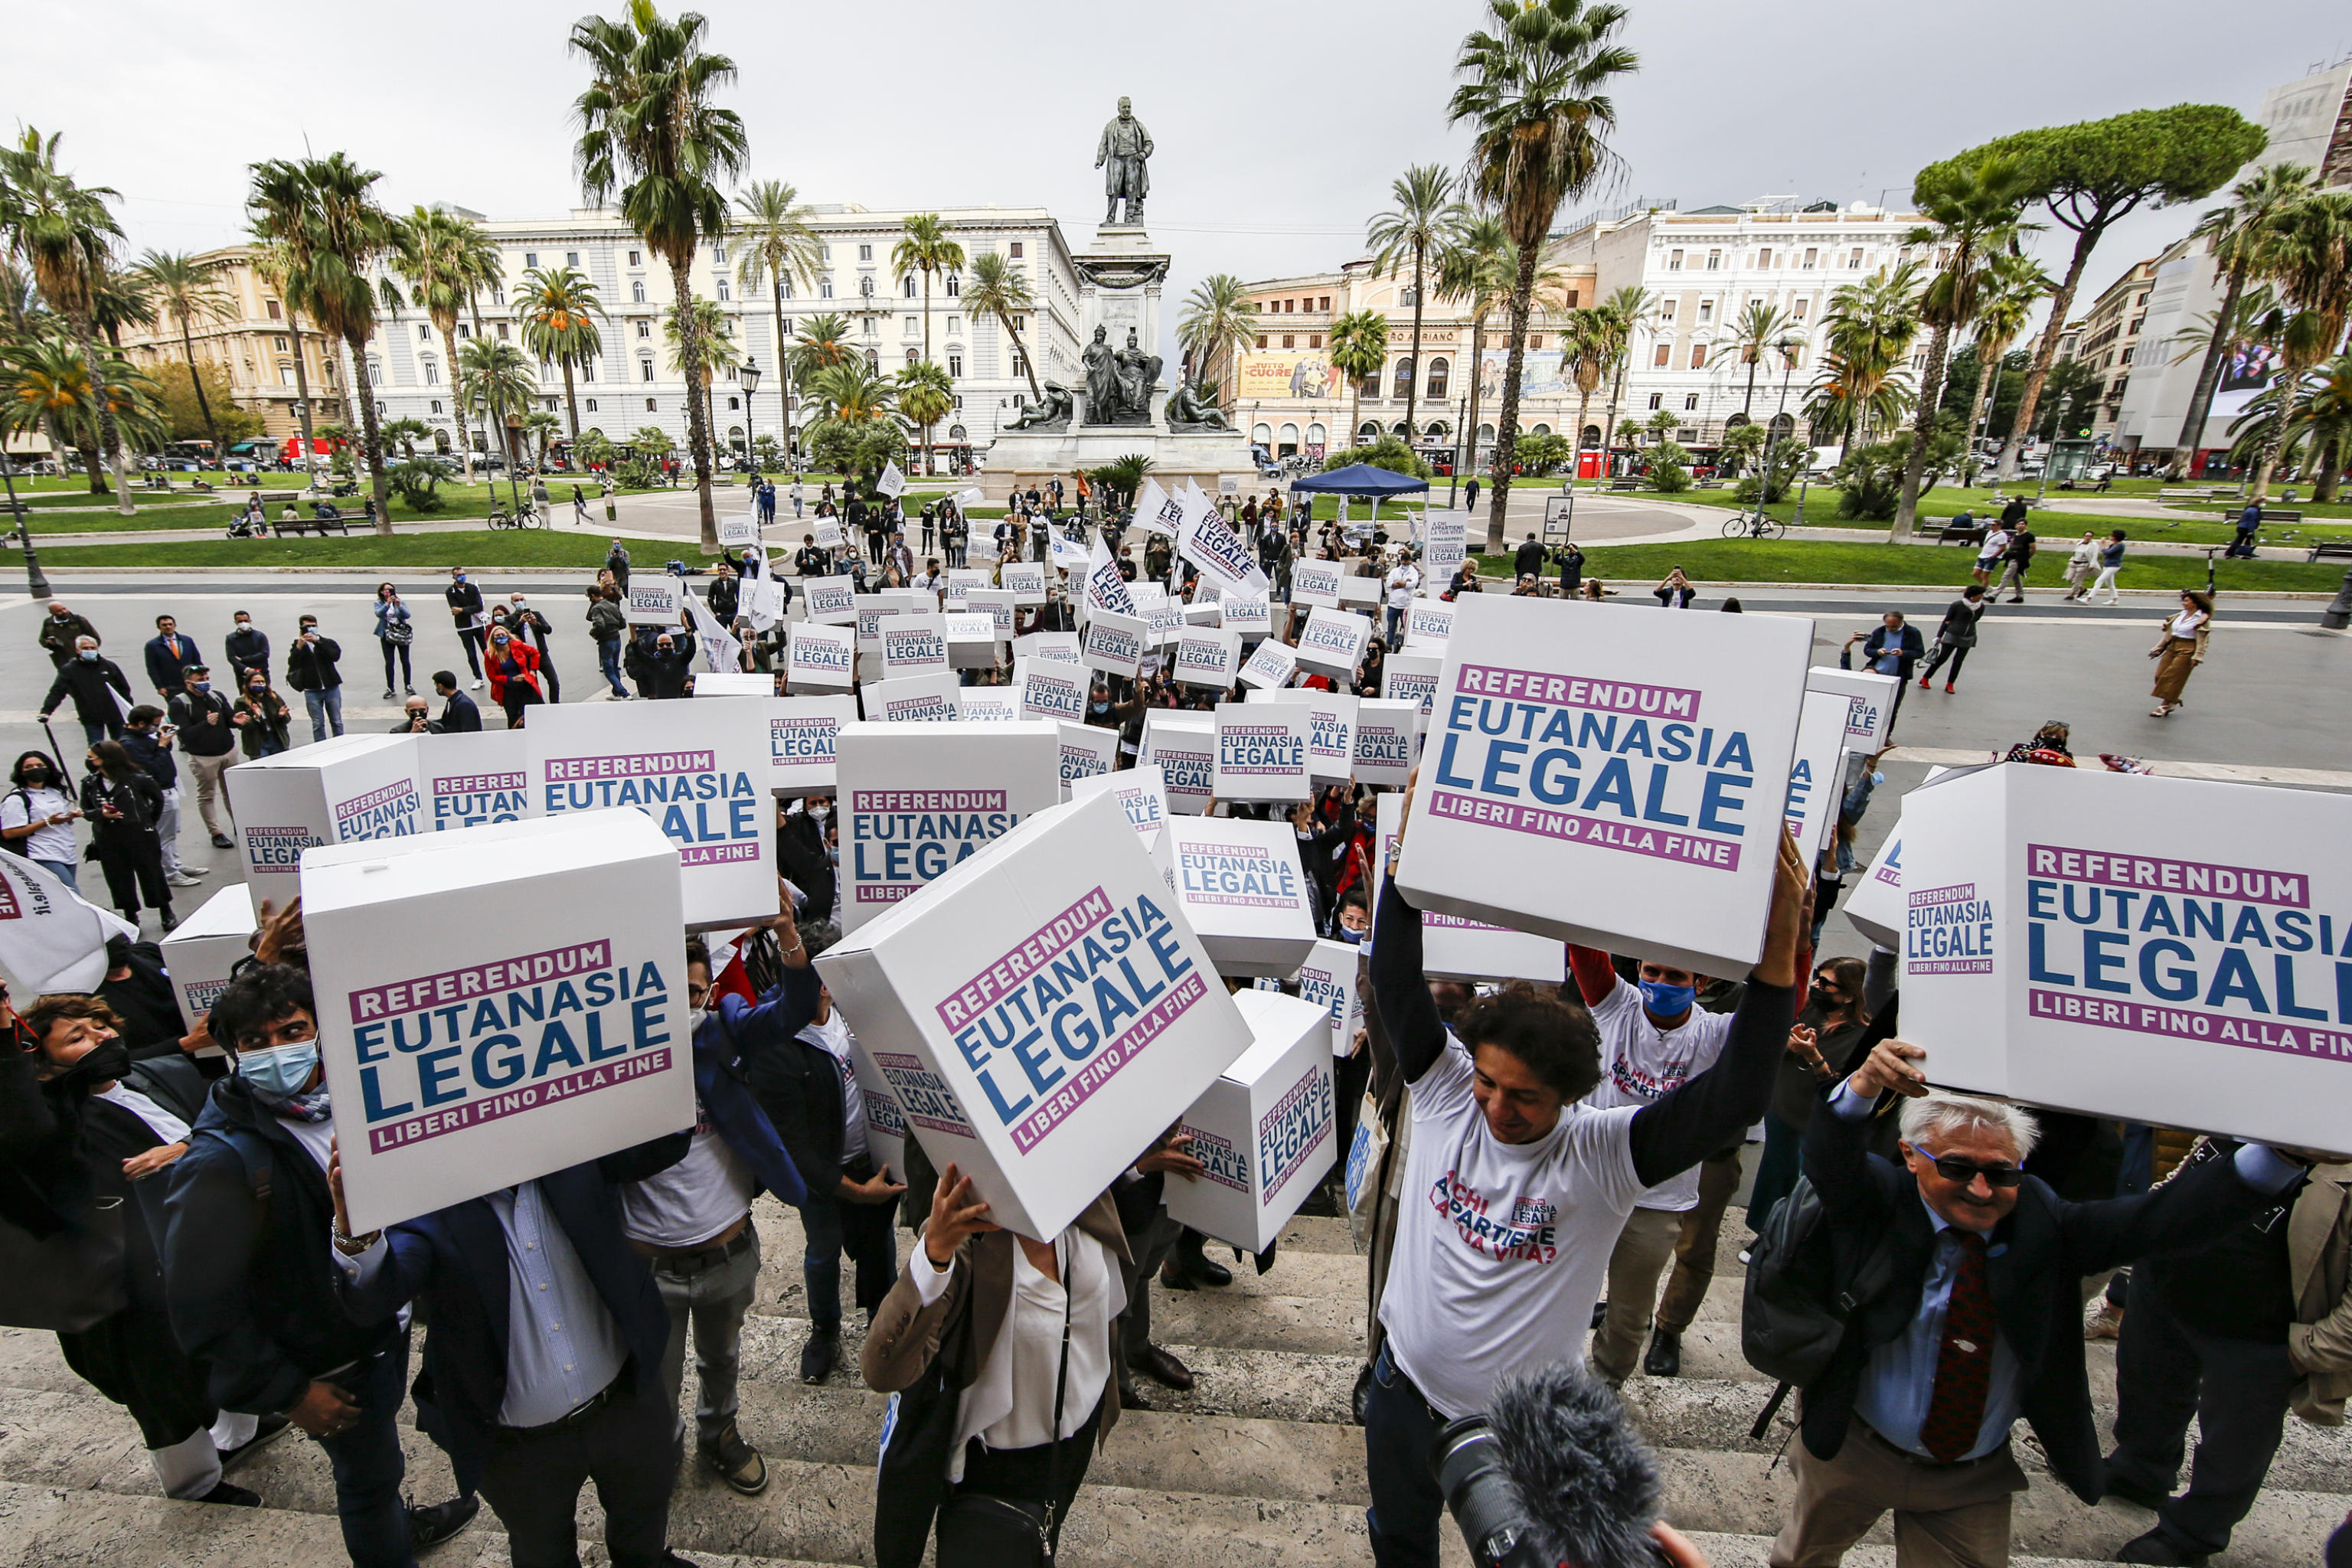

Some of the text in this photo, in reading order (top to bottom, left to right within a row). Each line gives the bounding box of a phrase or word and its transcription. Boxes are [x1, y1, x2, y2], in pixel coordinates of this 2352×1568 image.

[1407, 332, 1453, 341] ARIANO
[1250, 368, 1292, 377] CUORE
[1194, 524, 1255, 576] LEGALE
[1429, 553, 1464, 561] LEGALE
[811, 590, 853, 601] EUTANASIA
[1006, 581, 1043, 591] LEGALE
[1295, 578, 1338, 593] LEGALE
[630, 592, 673, 600] EUTANASIA
[630, 598, 673, 609] LEGALE
[812, 596, 854, 610] LEGALE
[1225, 607, 1268, 618] LEGALE
[887, 629, 930, 638] REFERENDUM
[1308, 623, 1357, 641] EUTANASIA
[1412, 619, 1451, 635] LEGAL
[794, 642, 850, 655] EUTANASIA
[886, 635, 943, 647] EUTANASIA
[1088, 637, 1139, 659] LEGALE
[1090, 629, 1139, 648] EUTANASIA
[1304, 630, 1357, 651] LEGALE
[793, 650, 850, 666] LEGALE
[887, 643, 944, 660] LEGALE
[1040, 652, 1080, 661] EUTANASIA
[1178, 651, 1227, 667] LEGALE
[1180, 644, 1227, 657] EUTANASIA
[1248, 656, 1286, 678] LEGALE
[1254, 651, 1289, 671] EUTANASIA
[1026, 681, 1083, 700] EUTANASIA
[1029, 675, 1073, 688] REFERENDUM
[1389, 681, 1436, 694] EUTANA
[1024, 690, 1083, 713] LEGALE
[1463, 668, 1692, 717] REFERENDUM
[887, 696, 941, 710] REFERENDUM
[887, 702, 956, 722] EUTANASIA
[772, 718, 834, 727] REFERENDUM
[770, 726, 841, 740] EUTANAS
[1220, 735, 1304, 748] EUTANASIA
[1310, 731, 1348, 750] ALE
[1355, 733, 1407, 746] TANASIA
[1447, 695, 1754, 773] EUTANASIA
[771, 737, 838, 757] LEGAL
[1155, 750, 1212, 761] REFERENDUM
[1220, 747, 1304, 766] LEGALE
[1353, 743, 1408, 760] EGALE
[550, 753, 710, 779] REFERENDUM
[1060, 753, 1107, 772] ANASIA
[1153, 757, 1215, 773] EUTANAS
[436, 773, 524, 793] REFEREN
[1163, 769, 1213, 788] EGAL
[1435, 733, 1753, 836] LEGALE
[338, 779, 410, 818] REFERENDUM
[545, 771, 755, 811] EUTANASIA
[858, 792, 1001, 809] REFERENDUM
[433, 789, 528, 818] EUTAN
[338, 791, 421, 841] EUTANASI
[661, 799, 758, 844] ALE
[247, 827, 306, 835] REFERENDUM
[854, 813, 1018, 840] EUTANASI
[1436, 795, 1731, 864] LIBERI FINO ALLA FINE
[247, 835, 325, 848] EUTANASIA
[1181, 843, 1266, 858] REFERENDUM
[249, 847, 307, 864] LEGA
[678, 844, 754, 864] LLA FINE
[1180, 854, 1293, 875] EUTANASIA
[1182, 868, 1298, 897] LEGALE
[2036, 848, 2299, 903] REFERENDUM
[860, 887, 911, 900] LIBERI
[1188, 893, 1297, 907] LIBERI FINO ALLA FINE
[1910, 885, 1973, 906] REFERENDUM
[1908, 900, 1993, 928] EUTANASIA
[2028, 880, 2352, 958] EUTANASI
[1908, 922, 1993, 959] LEGALE
[943, 892, 1107, 1027] REFERENDUM
[1909, 960, 1991, 972] LIBERI FINO ALLA FINE
[358, 944, 603, 1018] REFERENDUM
[955, 893, 1166, 1072] EUTANASIA
[1299, 977, 1345, 1001] NASIA
[354, 960, 666, 1064] EUTANASIA
[976, 920, 1193, 1126] LEGALE
[2037, 993, 2352, 1057] LIBERI FINO ALLA FIN
[360, 993, 670, 1123] LEGALE
[874, 1053, 923, 1069] REFERENDUM
[1017, 977, 1201, 1147] LIBERI FINO ALLA FINE
[881, 1067, 949, 1093] EUTANASIA
[1612, 1062, 1665, 1099] APPARTI
[1631, 1068, 1656, 1089] MIA
[377, 1052, 665, 1148] LIBERI FINO ALLA FINE
[892, 1086, 967, 1122] LEGALE
[1261, 1067, 1315, 1134] REFERENDUM
[867, 1106, 906, 1131] LEGA
[1259, 1070, 1330, 1159] EUTANASIA
[1178, 1125, 1230, 1148] EFERENDUM
[1261, 1087, 1331, 1191] LEGALE
[1190, 1137, 1247, 1168] TANASIA
[1264, 1120, 1330, 1203] LIBERI FINO ALLA FINE
[1184, 1145, 1249, 1184] EGALE
[1452, 1182, 1489, 1216] CHI
[1513, 1203, 1557, 1214] EUTANASIA
[1434, 1176, 1556, 1248] APARTIENE
[1511, 1210, 1557, 1224] LEGALE
